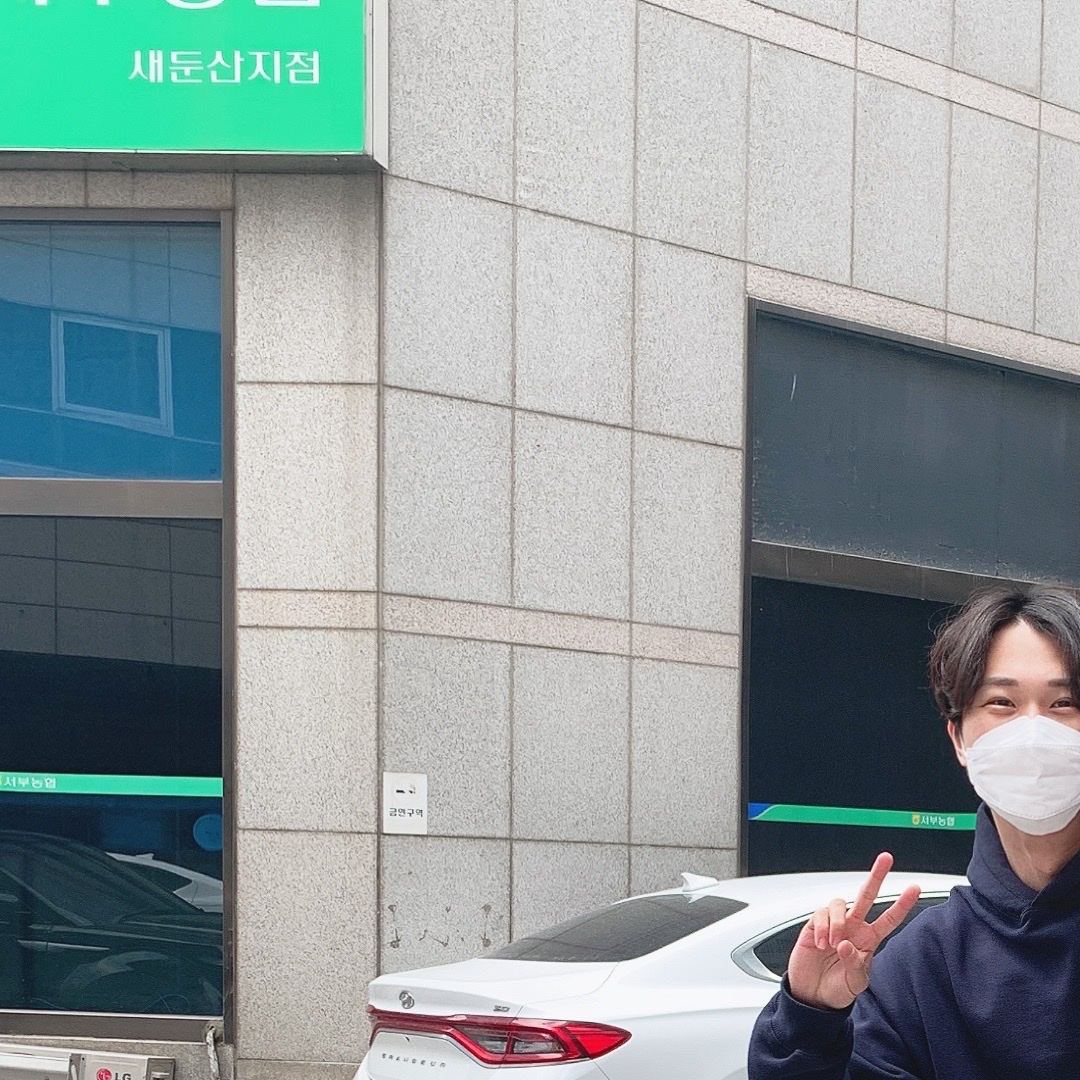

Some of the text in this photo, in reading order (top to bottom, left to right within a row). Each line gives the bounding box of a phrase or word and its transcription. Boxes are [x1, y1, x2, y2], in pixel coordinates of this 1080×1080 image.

[128, 49, 320, 84] 새둔산지점
[4, 777, 57, 789] 서부농협
[389, 807, 423, 818] 금연구역
[920, 815, 955, 827] 서부농협
